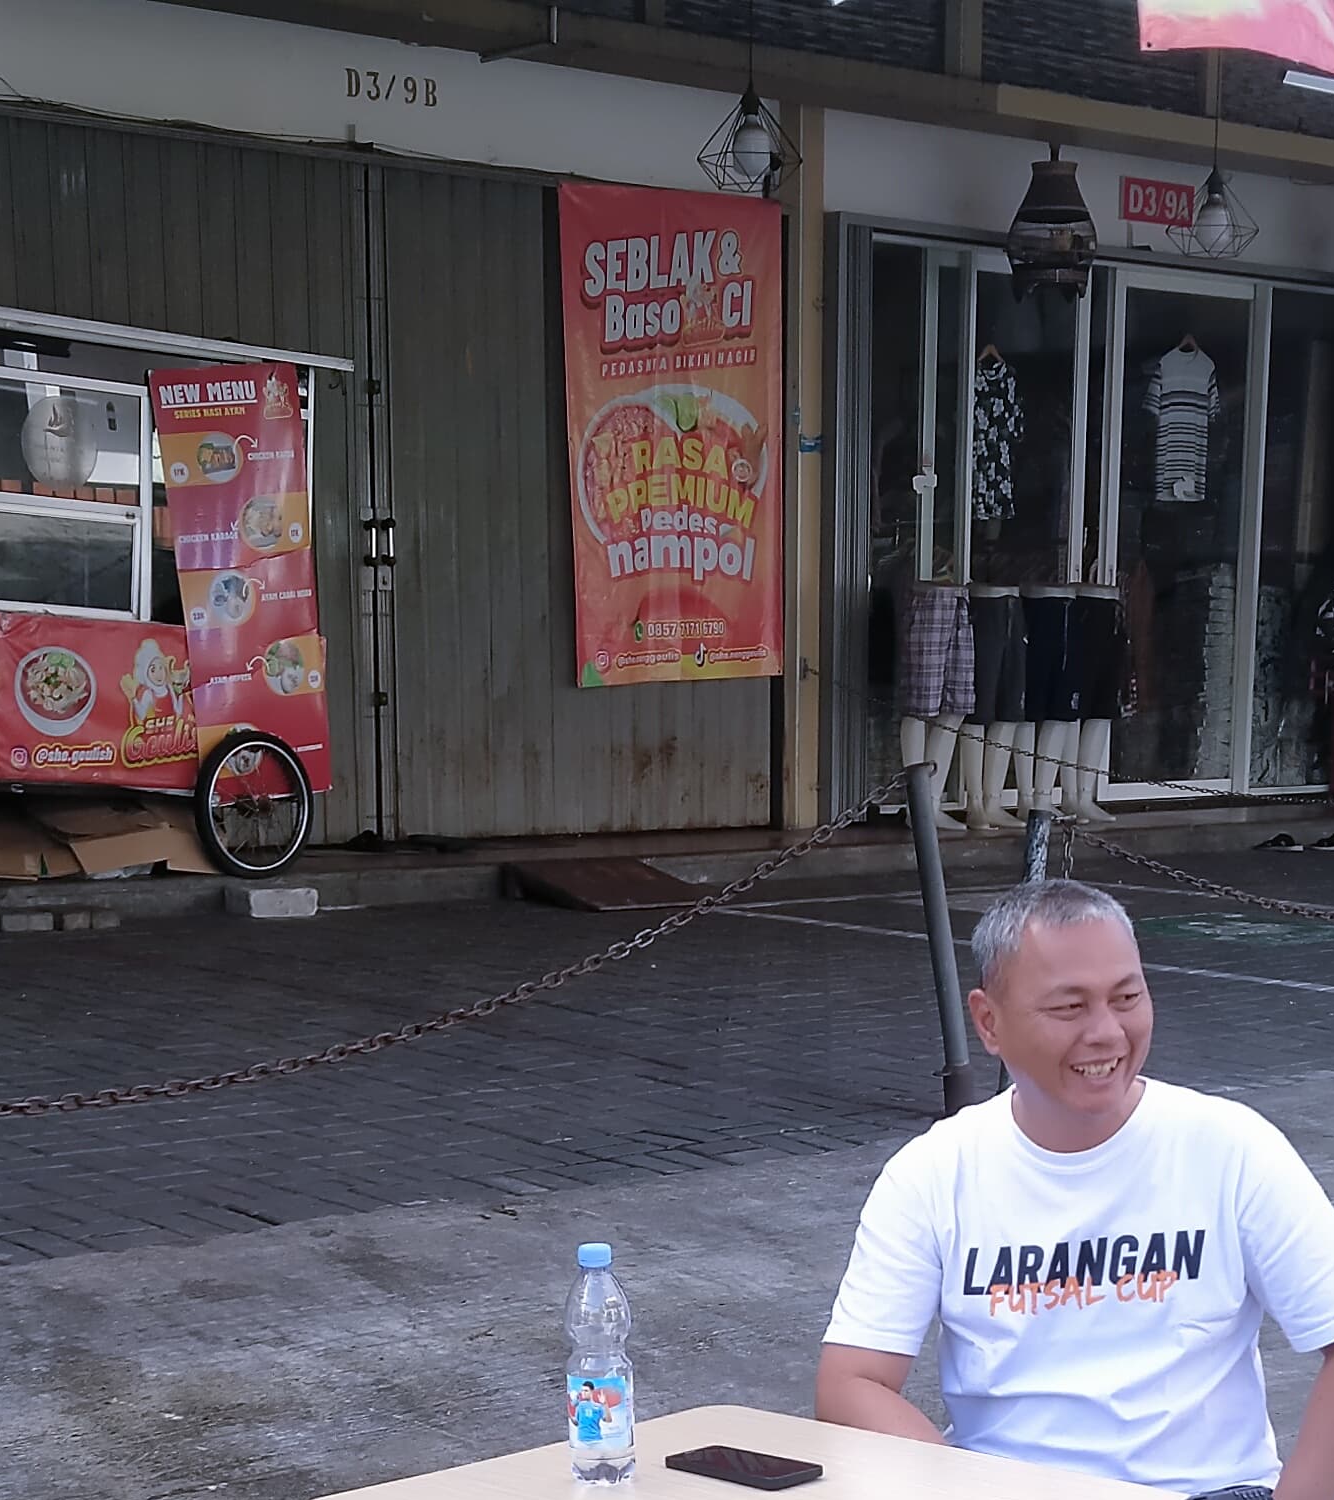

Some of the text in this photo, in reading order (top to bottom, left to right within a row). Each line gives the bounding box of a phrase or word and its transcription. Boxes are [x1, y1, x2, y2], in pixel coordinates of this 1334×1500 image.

[344, 67, 438, 107] D3/9B
[1128, 184, 1190, 220] D3/9A
[584, 230, 717, 298] SEBLAK
[605, 294, 681, 343] Baso
[159, 380, 257, 405] NEW MENU
[631, 436, 729, 481] RASA
[606, 473, 757, 529] PREMIUM
[640, 504, 717, 535] Pedes
[607, 534, 756, 581] nampol
[648, 621, 725, 637] 0857 7171 6790
[963, 1229, 1206, 1297] LARANGAN
[988, 1269, 1179, 1318] FUTSAL CUP
